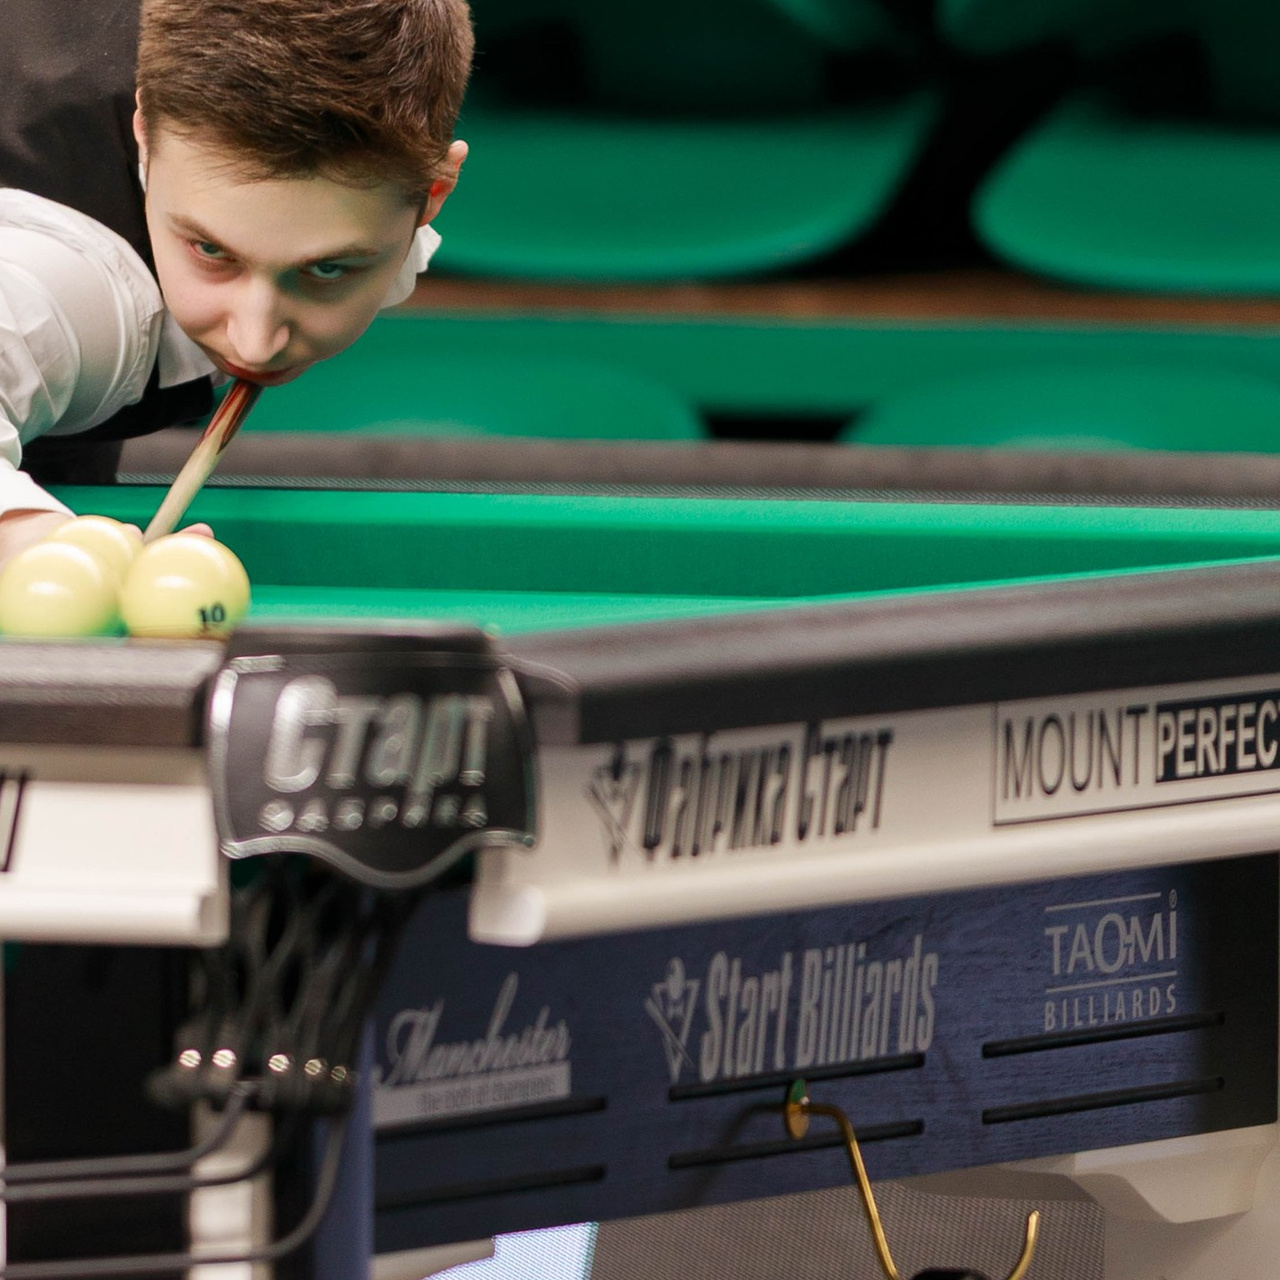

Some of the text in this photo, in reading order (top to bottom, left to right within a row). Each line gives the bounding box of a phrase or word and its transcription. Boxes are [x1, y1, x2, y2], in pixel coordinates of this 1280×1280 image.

[197, 601, 226, 631] 10
[1003, 699, 1280, 800] MOUNT PERFEC
[699, 933, 939, 1084] Start Billiards
[1044, 983, 1177, 1032] BILLIARDS
